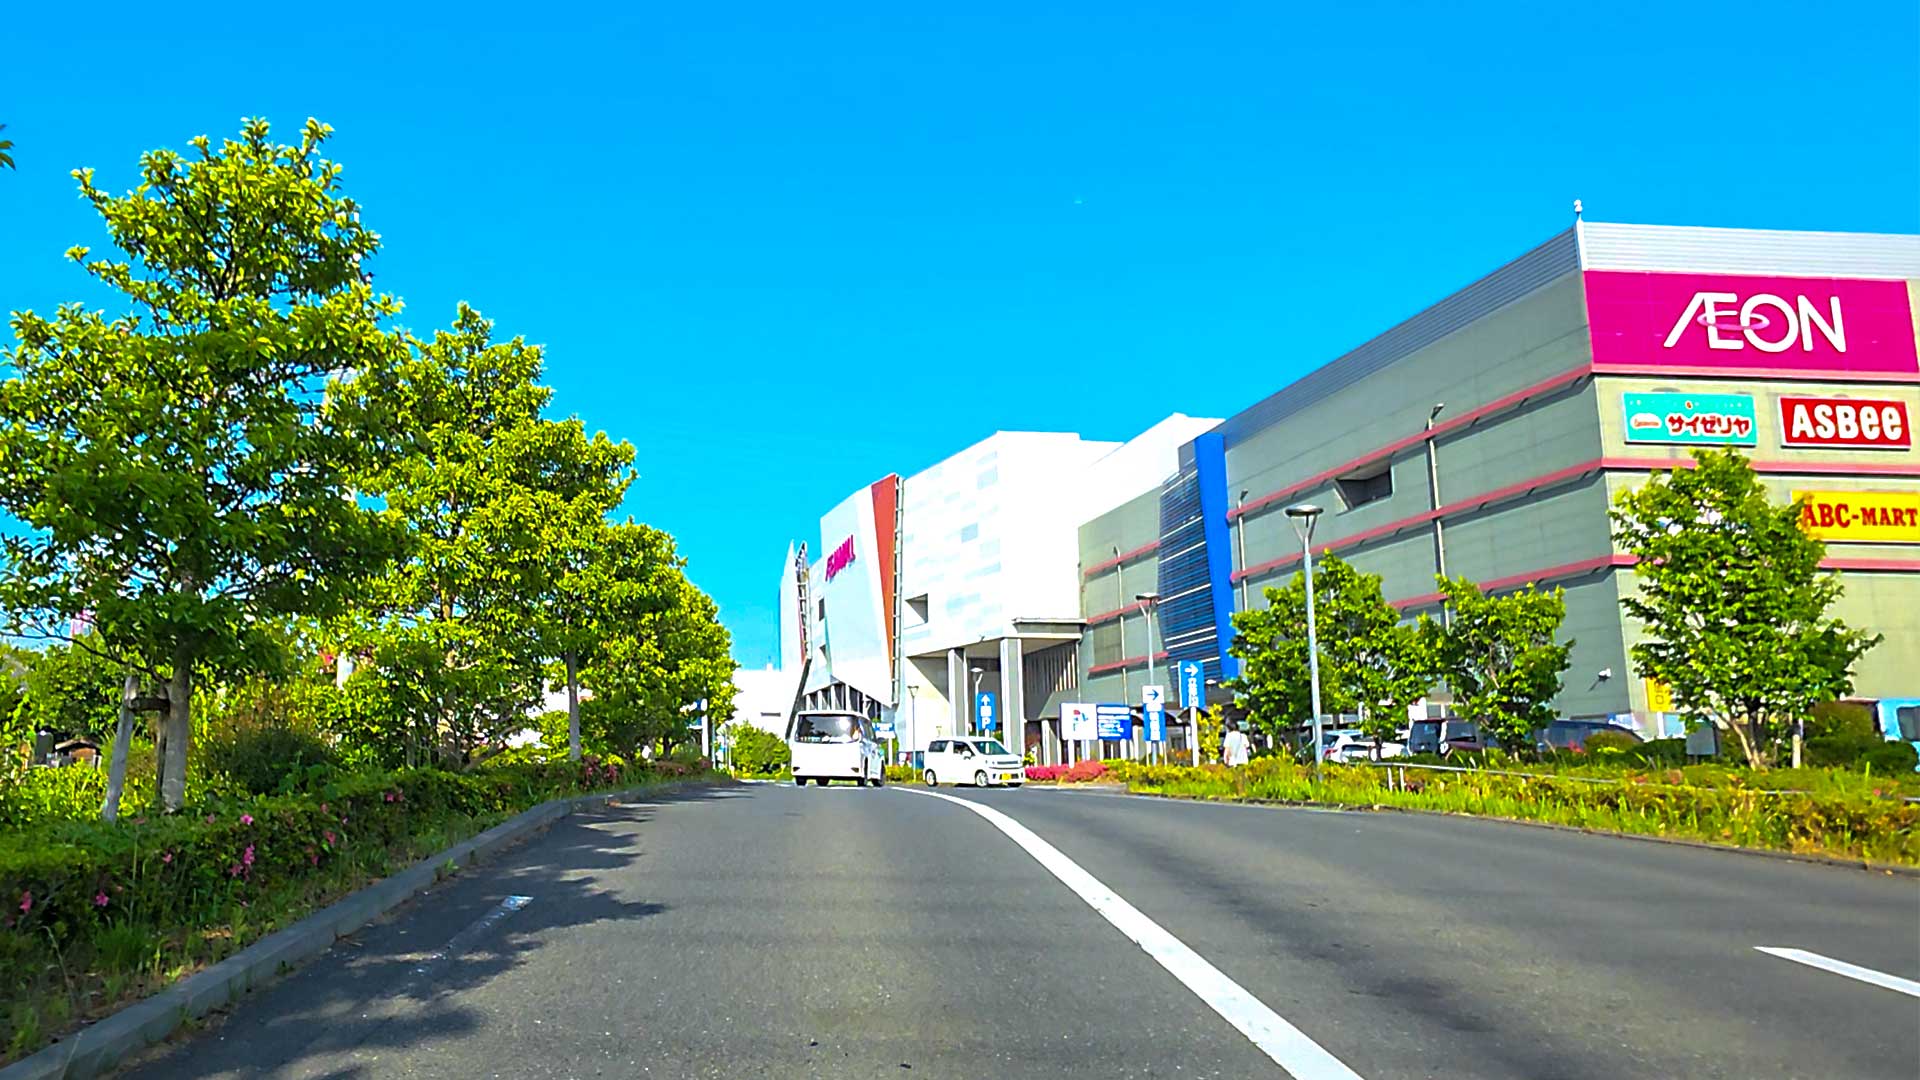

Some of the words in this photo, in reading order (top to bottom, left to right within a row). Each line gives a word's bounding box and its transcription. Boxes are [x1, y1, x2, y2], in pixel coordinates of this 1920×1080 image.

[1667, 414, 1751, 436] サイゼリヤ
[1792, 404, 1902, 440] ASBee
[1802, 502, 1918, 528] ABC-MART
